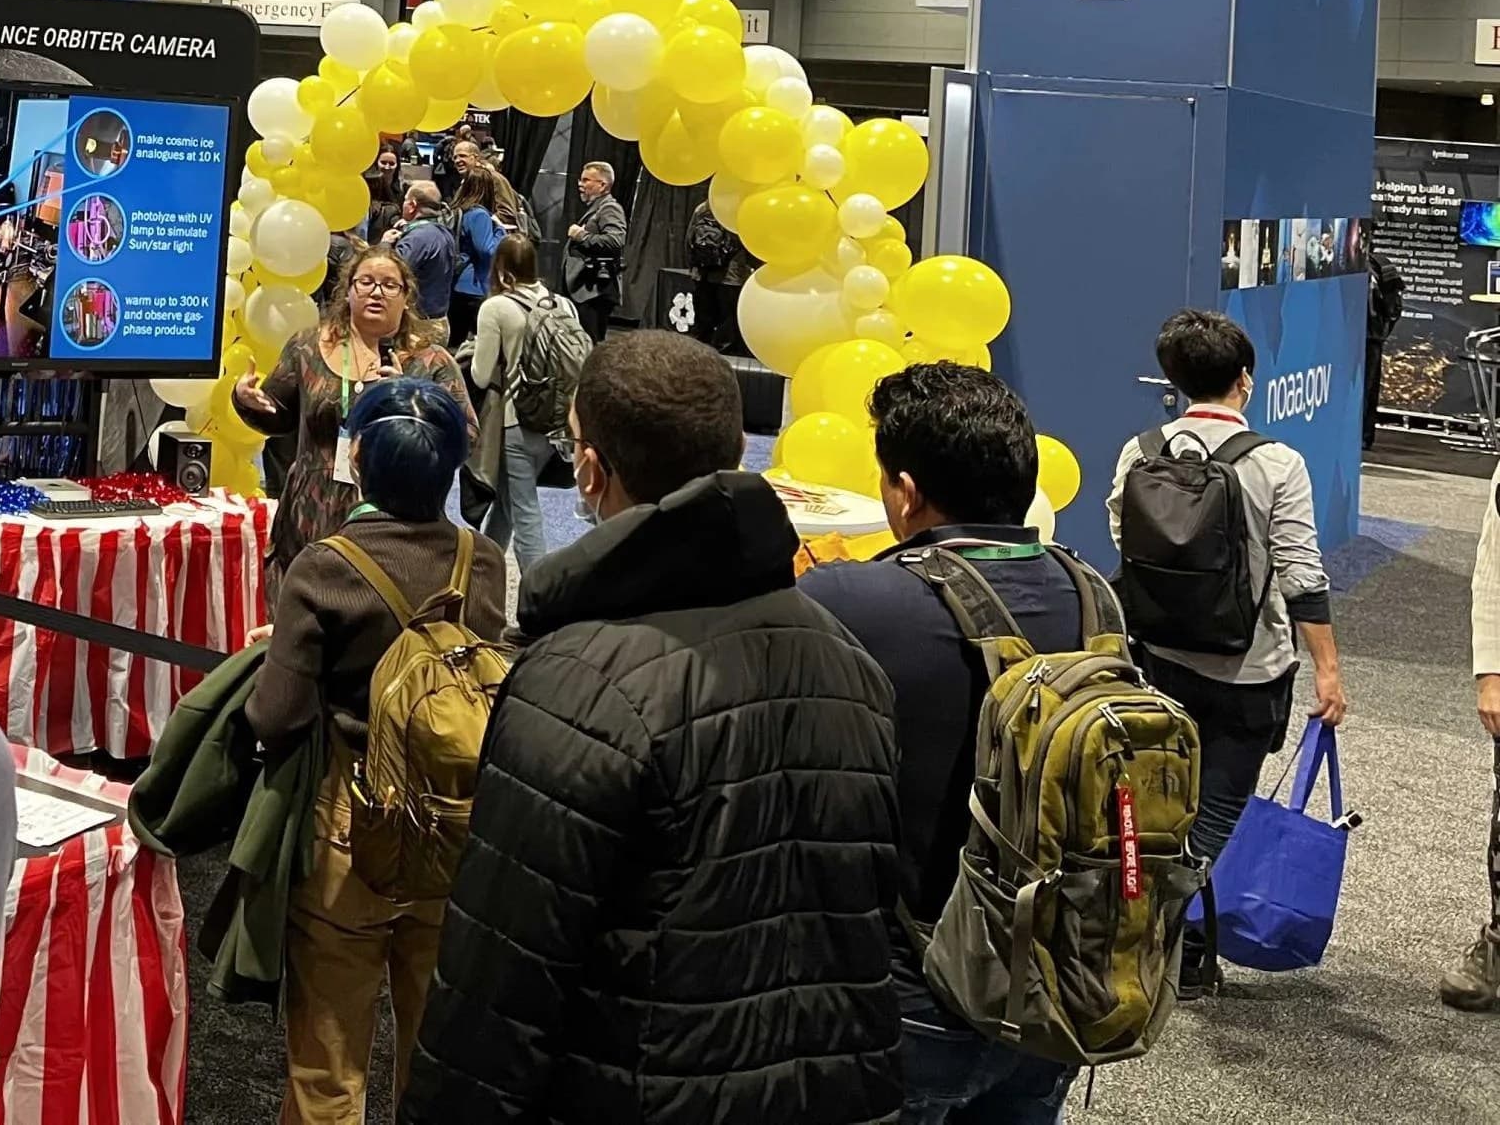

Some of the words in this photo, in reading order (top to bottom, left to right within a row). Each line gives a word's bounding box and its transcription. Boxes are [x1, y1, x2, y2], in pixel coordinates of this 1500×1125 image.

[747, 14, 760, 33] it
[44, 27, 125, 52] ORBITER
[130, 34, 216, 59] CAMERA
[137, 134, 164, 145] make
[166, 136, 198, 148] cosmic
[200, 138, 214, 148] ice
[136, 149, 184, 162] analogues
[187, 152, 197, 161] at
[199, 151, 211, 162] 10
[213, 152, 221, 162] K
[1376, 181, 1417, 194] Helping
[1419, 183, 1446, 195] build
[1447, 187, 1455, 195] a
[1371, 193, 1405, 203] eather
[1407, 194, 1427, 205] and
[1429, 196, 1461, 206] climat
[1382, 204, 1412, 216] ready
[1414, 206, 1447, 217] nation
[131, 211, 176, 224] photolyze
[178, 212, 197, 223] with
[200, 213, 212, 224] UV
[130, 225, 154, 237] lamp
[156, 226, 165, 236] to
[167, 226, 208, 238] simulate
[129, 238, 171, 251] Sun/star
[173, 241, 193, 253] light
[125, 296, 151, 306] warm
[153, 298, 166, 308] up
[168, 297, 178, 306] to
[180, 296, 200, 307] 300
[201, 297, 209, 307] K
[124, 310, 143, 320] and
[144, 310, 182, 321] observe
[184, 312, 203, 323] gas-
[123, 324, 152, 336] phase
[155, 324, 195, 337] products
[1267, 363, 1332, 424] noaa.gov
